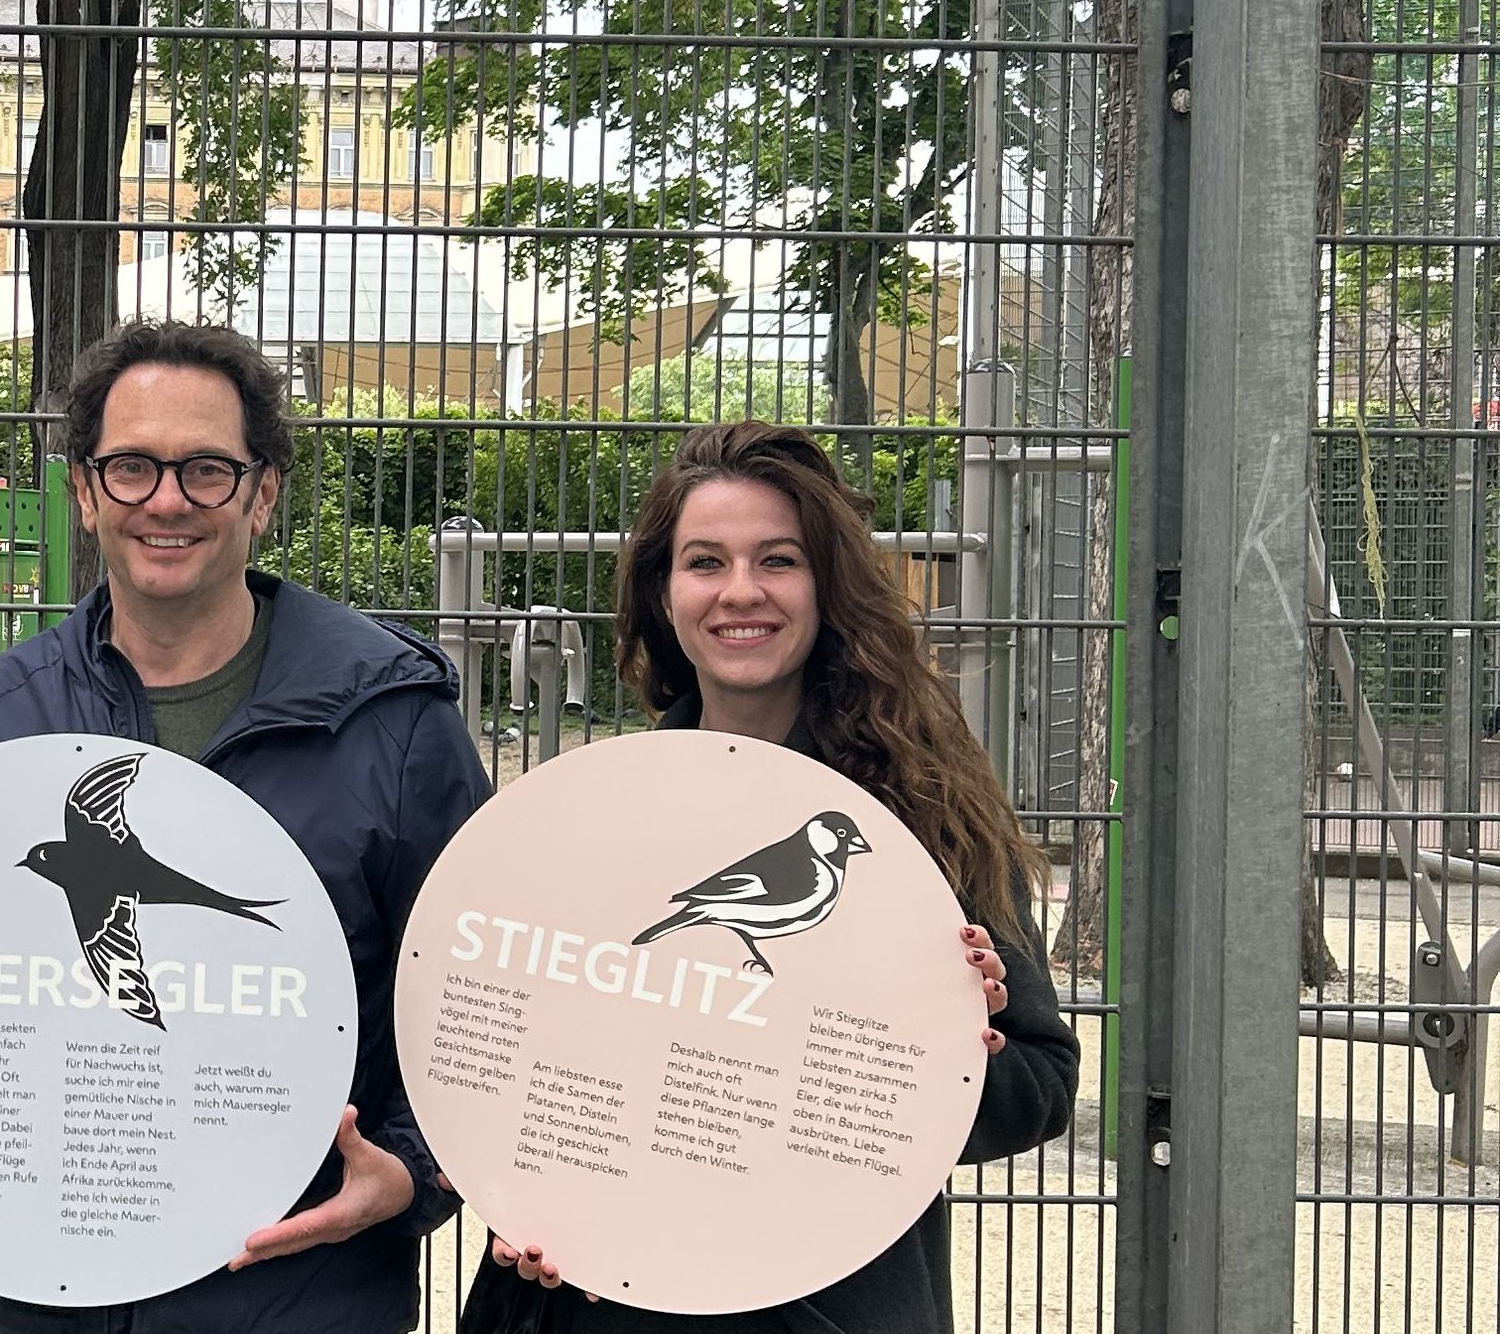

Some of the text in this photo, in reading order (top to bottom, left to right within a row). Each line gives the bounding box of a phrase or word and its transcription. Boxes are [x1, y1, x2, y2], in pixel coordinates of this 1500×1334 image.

[450, 909, 775, 1028] STIEGLITZ
[446, 972, 531, 1001] Ich bin einer der
[442, 987, 526, 1019] buntesten Sing-
[439, 1005, 528, 1033] vögel mit meiner
[436, 1019, 519, 1049] leuchtend roten
[433, 1036, 512, 1064] Gesichtsmaske
[670, 1041, 779, 1077] Deshalb nennt man
[194, 1064, 271, 1078] Jetzt weißt du
[427, 1067, 501, 1096] Flügelstreifen.
[430, 1054, 516, 1081] und dem gelben
[666, 1061, 742, 1086] mich auch oft
[193, 1080, 289, 1095] auch, warum man
[663, 1074, 777, 1111] Distelfink. Nur wenn
[193, 1097, 291, 1115] mich Mauersegler
[660, 1091, 775, 1129] diese Pflanzen lange
[193, 1116, 228, 1126] nennt.
[656, 1109, 741, 1139] stehen bleiben,
[653, 1123, 736, 1154] komme ich gut
[650, 1141, 750, 1174] durch den Winter.
